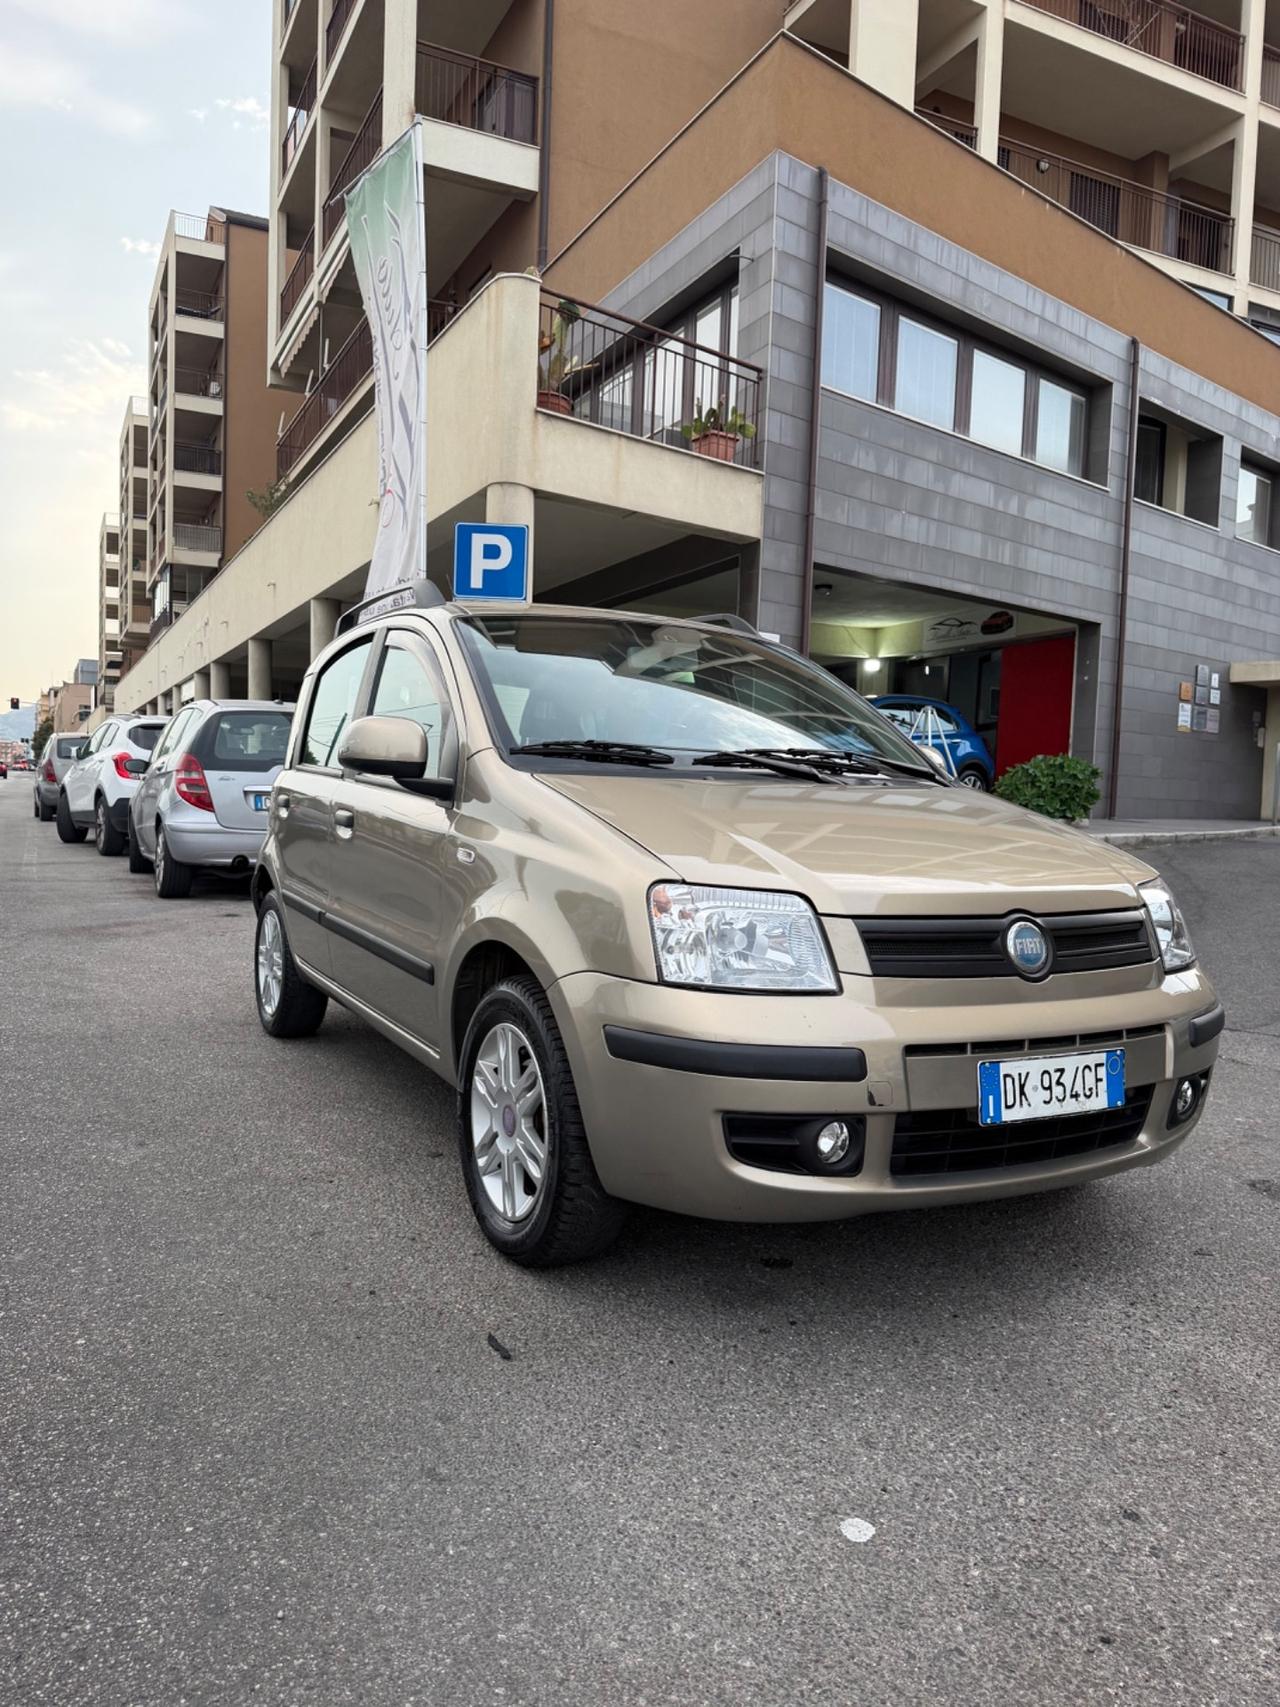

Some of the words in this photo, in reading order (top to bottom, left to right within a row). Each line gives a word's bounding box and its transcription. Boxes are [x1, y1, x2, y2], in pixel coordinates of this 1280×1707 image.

[470, 533, 512, 588] P
[1015, 937, 1041, 955] FIAT
[1002, 1071, 1031, 1109] DK
[1040, 1062, 1105, 1105] 934GF
